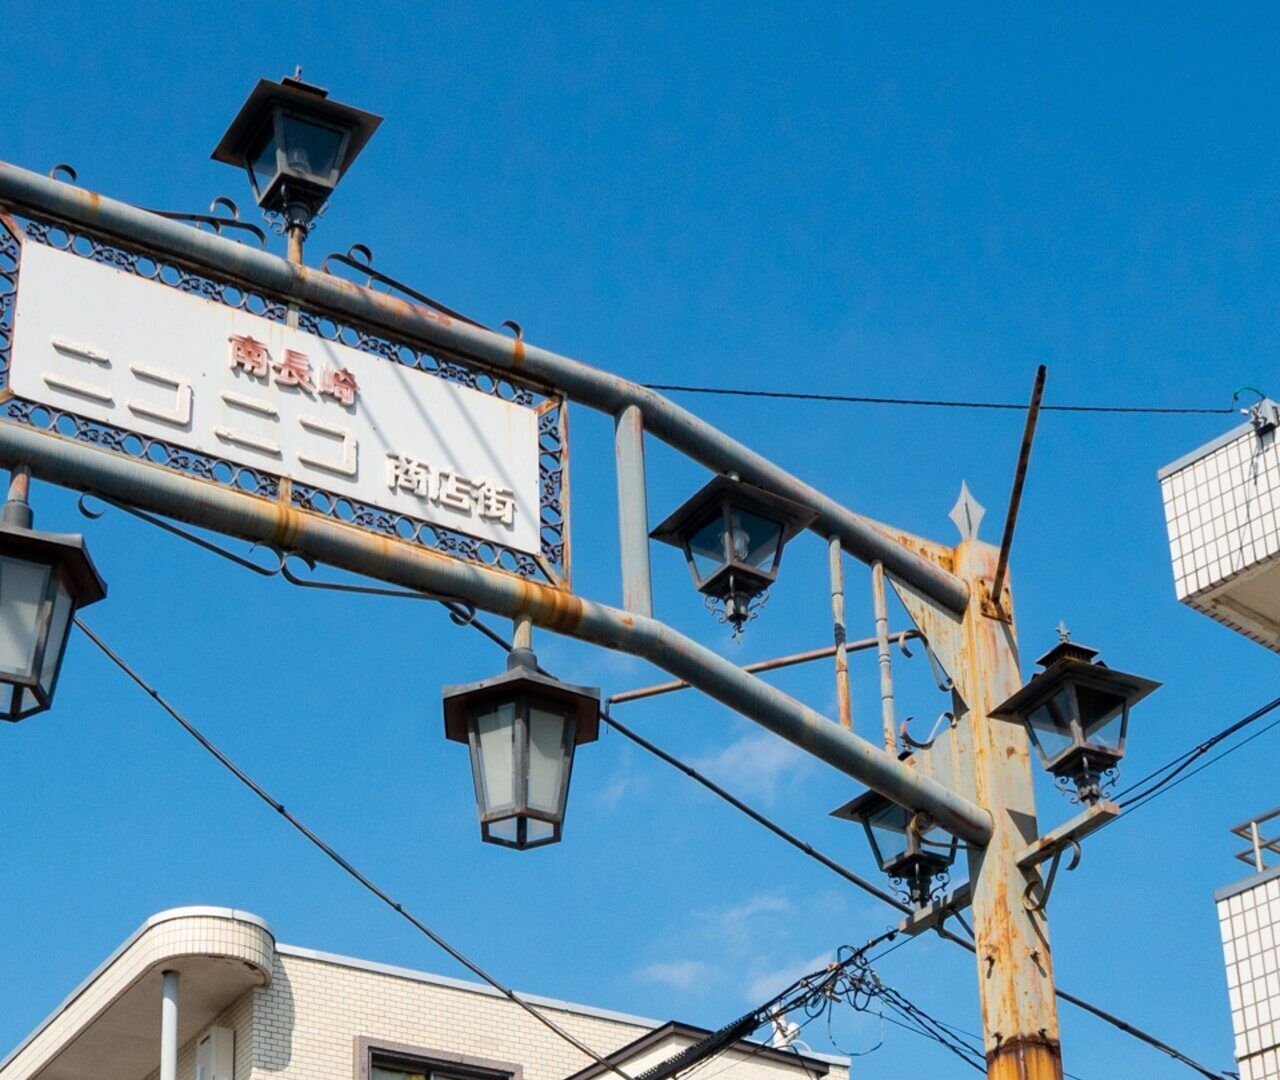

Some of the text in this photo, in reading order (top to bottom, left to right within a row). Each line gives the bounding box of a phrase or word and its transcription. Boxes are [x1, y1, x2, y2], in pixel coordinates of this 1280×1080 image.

[42, 336, 514, 524] ニコニコ 商店街
[228, 333, 357, 407] 南長崎
